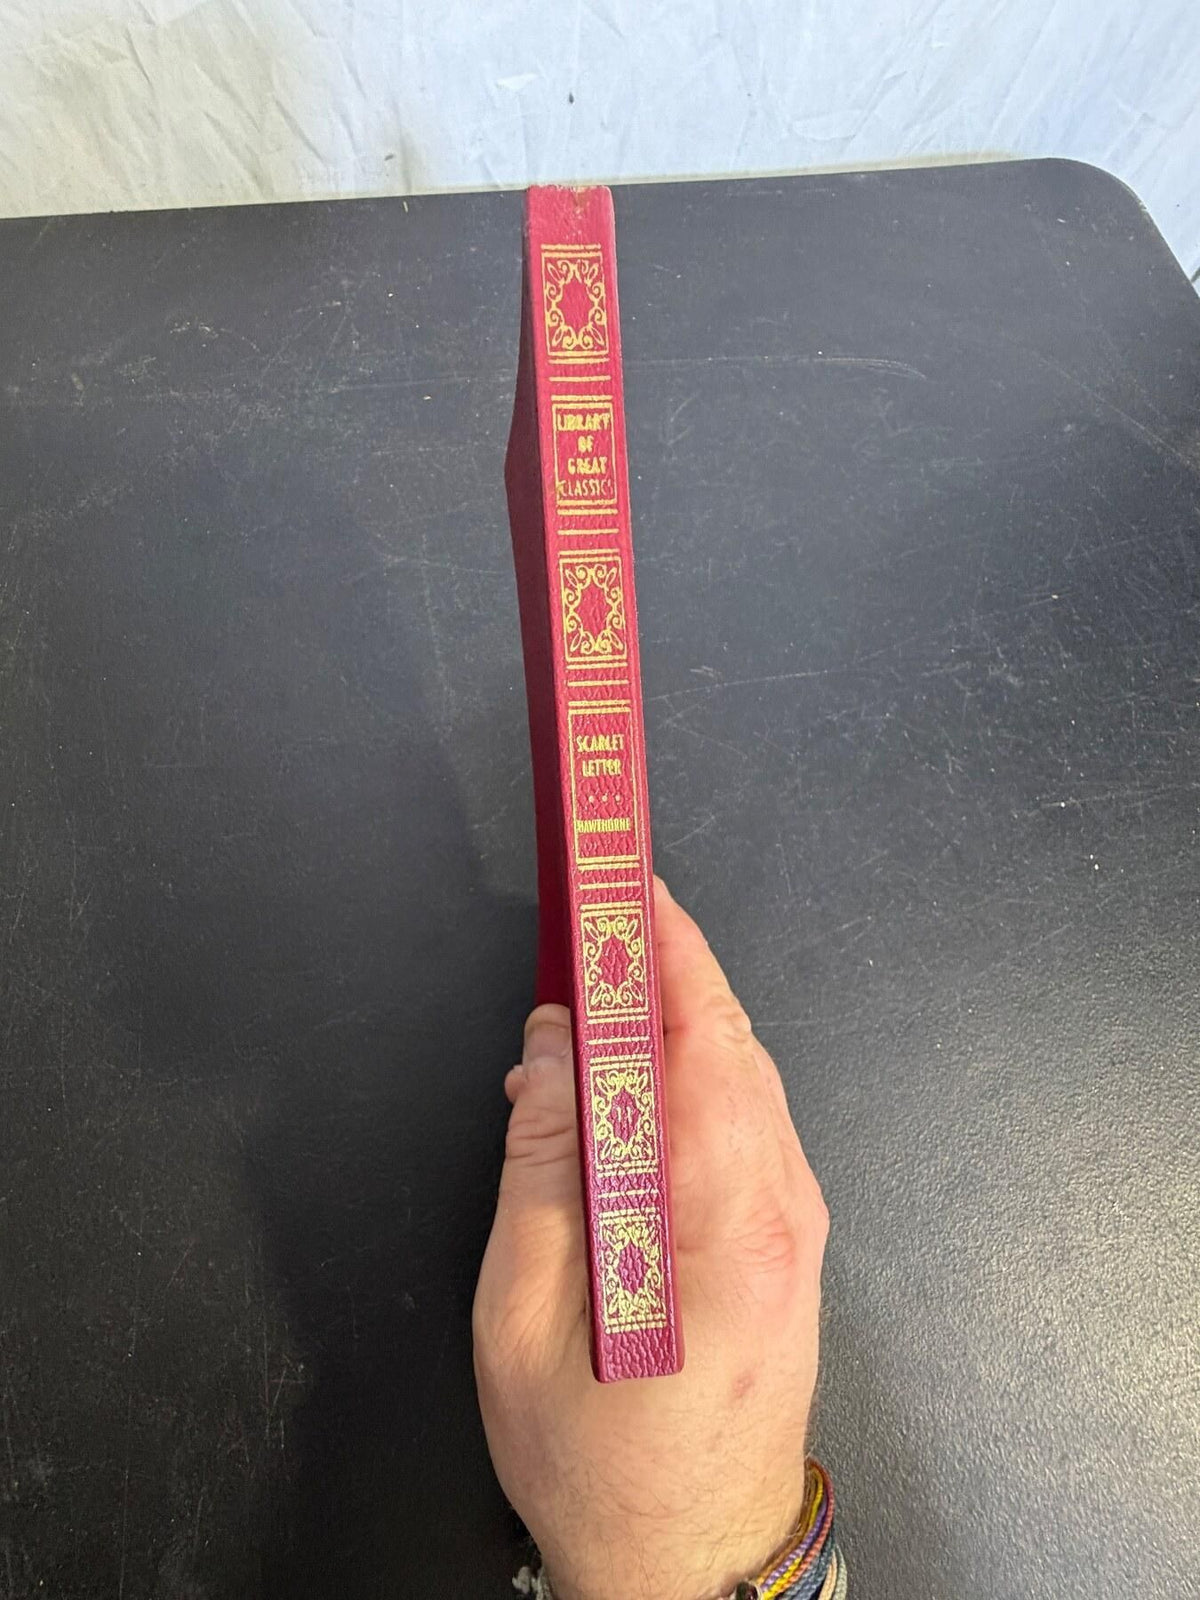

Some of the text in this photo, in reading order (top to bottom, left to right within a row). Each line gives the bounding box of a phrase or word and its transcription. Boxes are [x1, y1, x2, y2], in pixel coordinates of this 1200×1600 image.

[557, 413, 611, 431] LIBRARY
[578, 435, 594, 452] OF
[568, 456, 608, 475] GREAT
[576, 734, 624, 752] SCARLET
[582, 760, 621, 776] LETTER
[577, 818, 630, 833] HAWTHORNE
